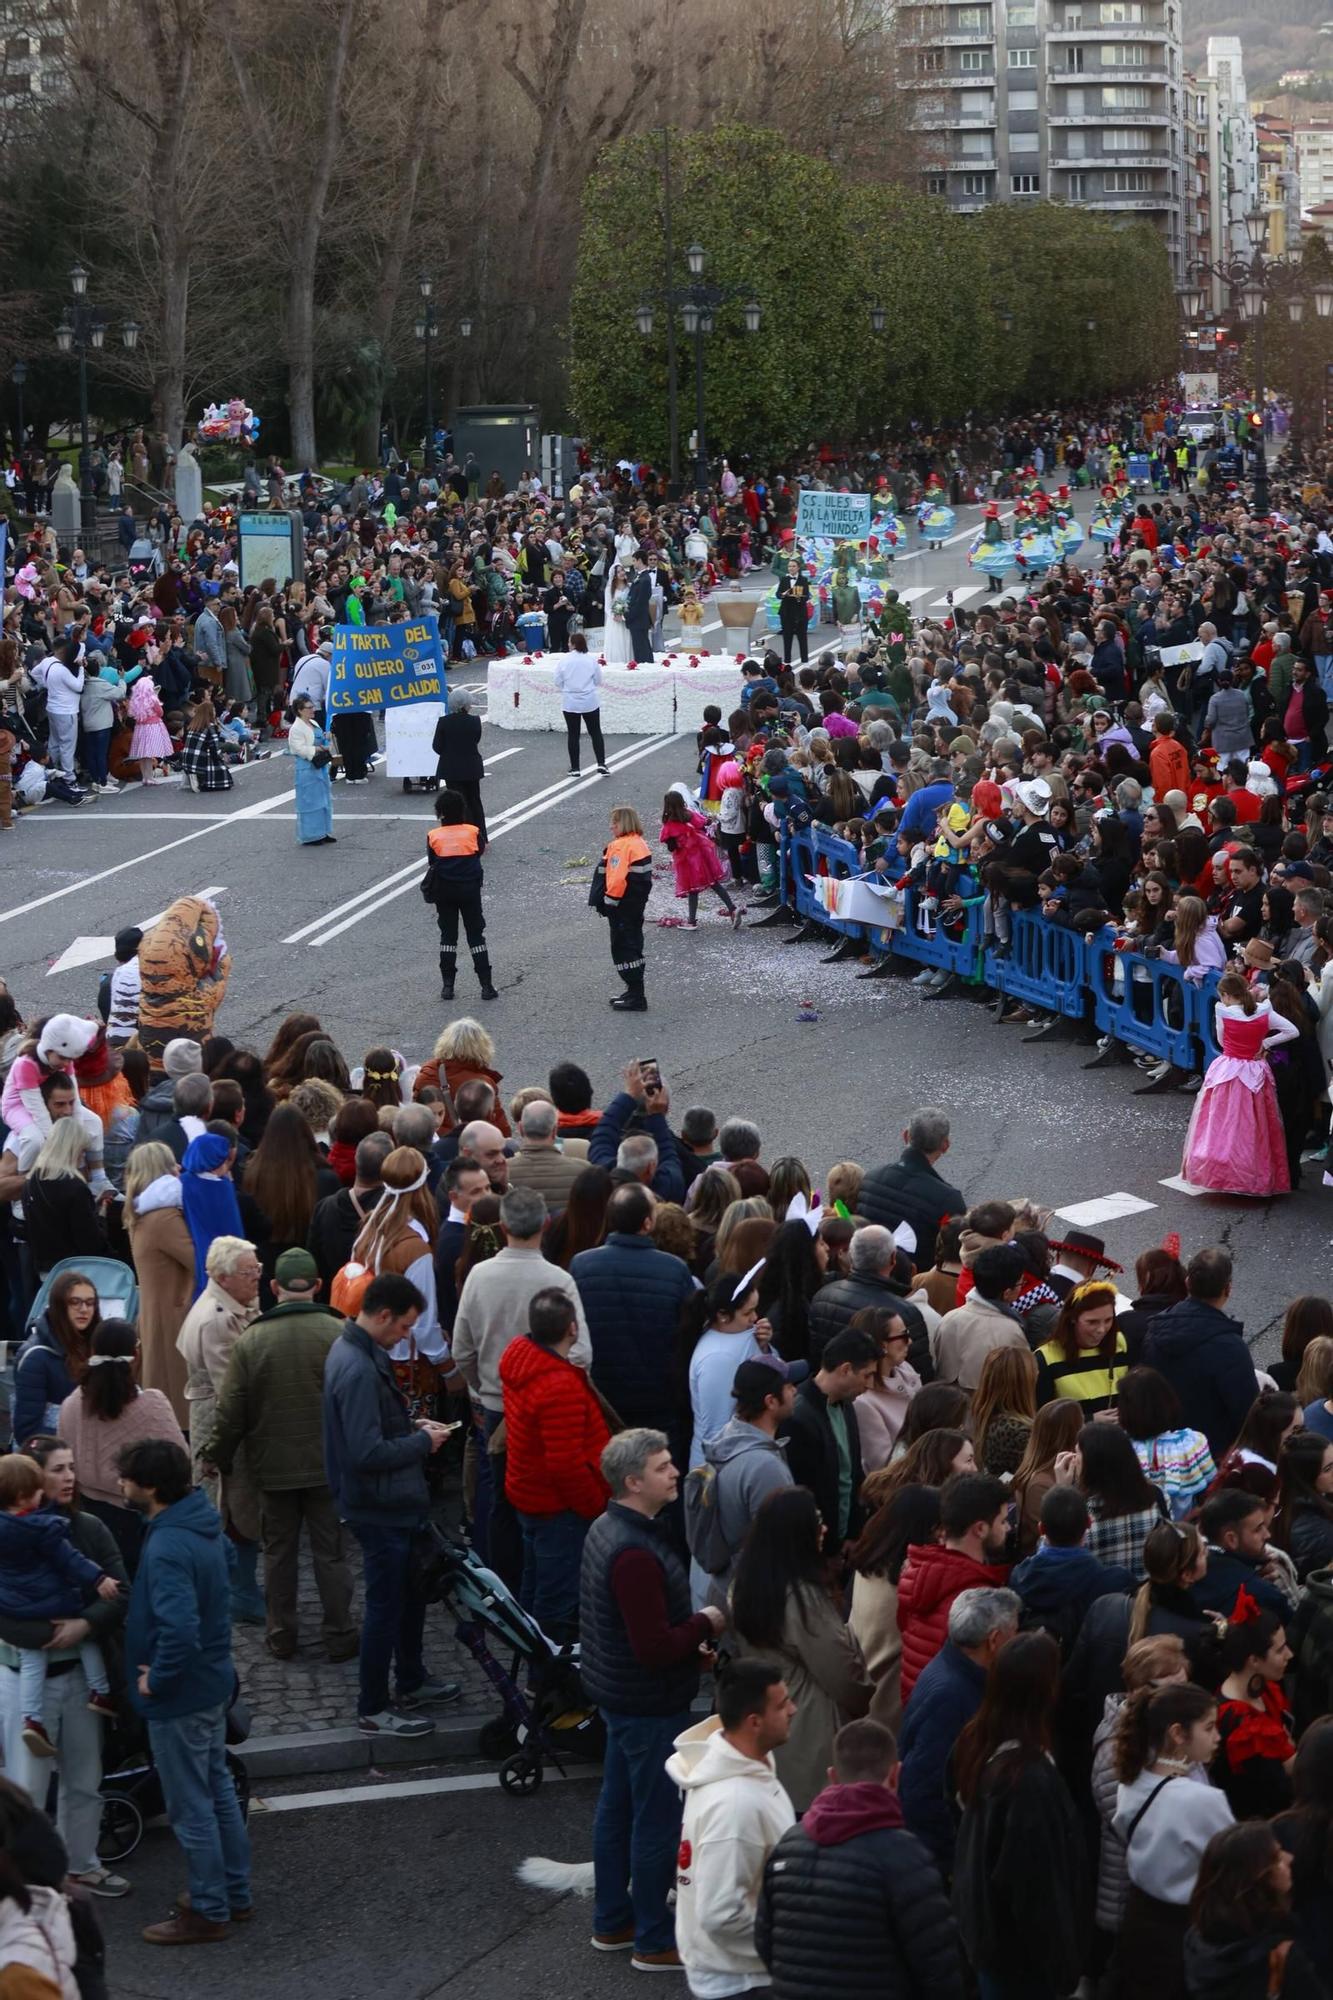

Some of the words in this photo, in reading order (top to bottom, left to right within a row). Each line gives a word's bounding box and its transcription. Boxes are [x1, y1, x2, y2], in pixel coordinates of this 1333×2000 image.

[802, 508, 815, 520] DA
[831, 509, 864, 522] VUELTA
[803, 521, 814, 532] AL
[823, 522, 858, 534] MUNDO
[335, 633, 347, 650] LA
[351, 633, 391, 650] TARTA
[405, 625, 432, 643] DEL
[421, 662, 435, 672] 031
[331, 691, 354, 708] C.S.
[358, 688, 383, 705] SAN
[390, 679, 440, 700] CLAUDIO
